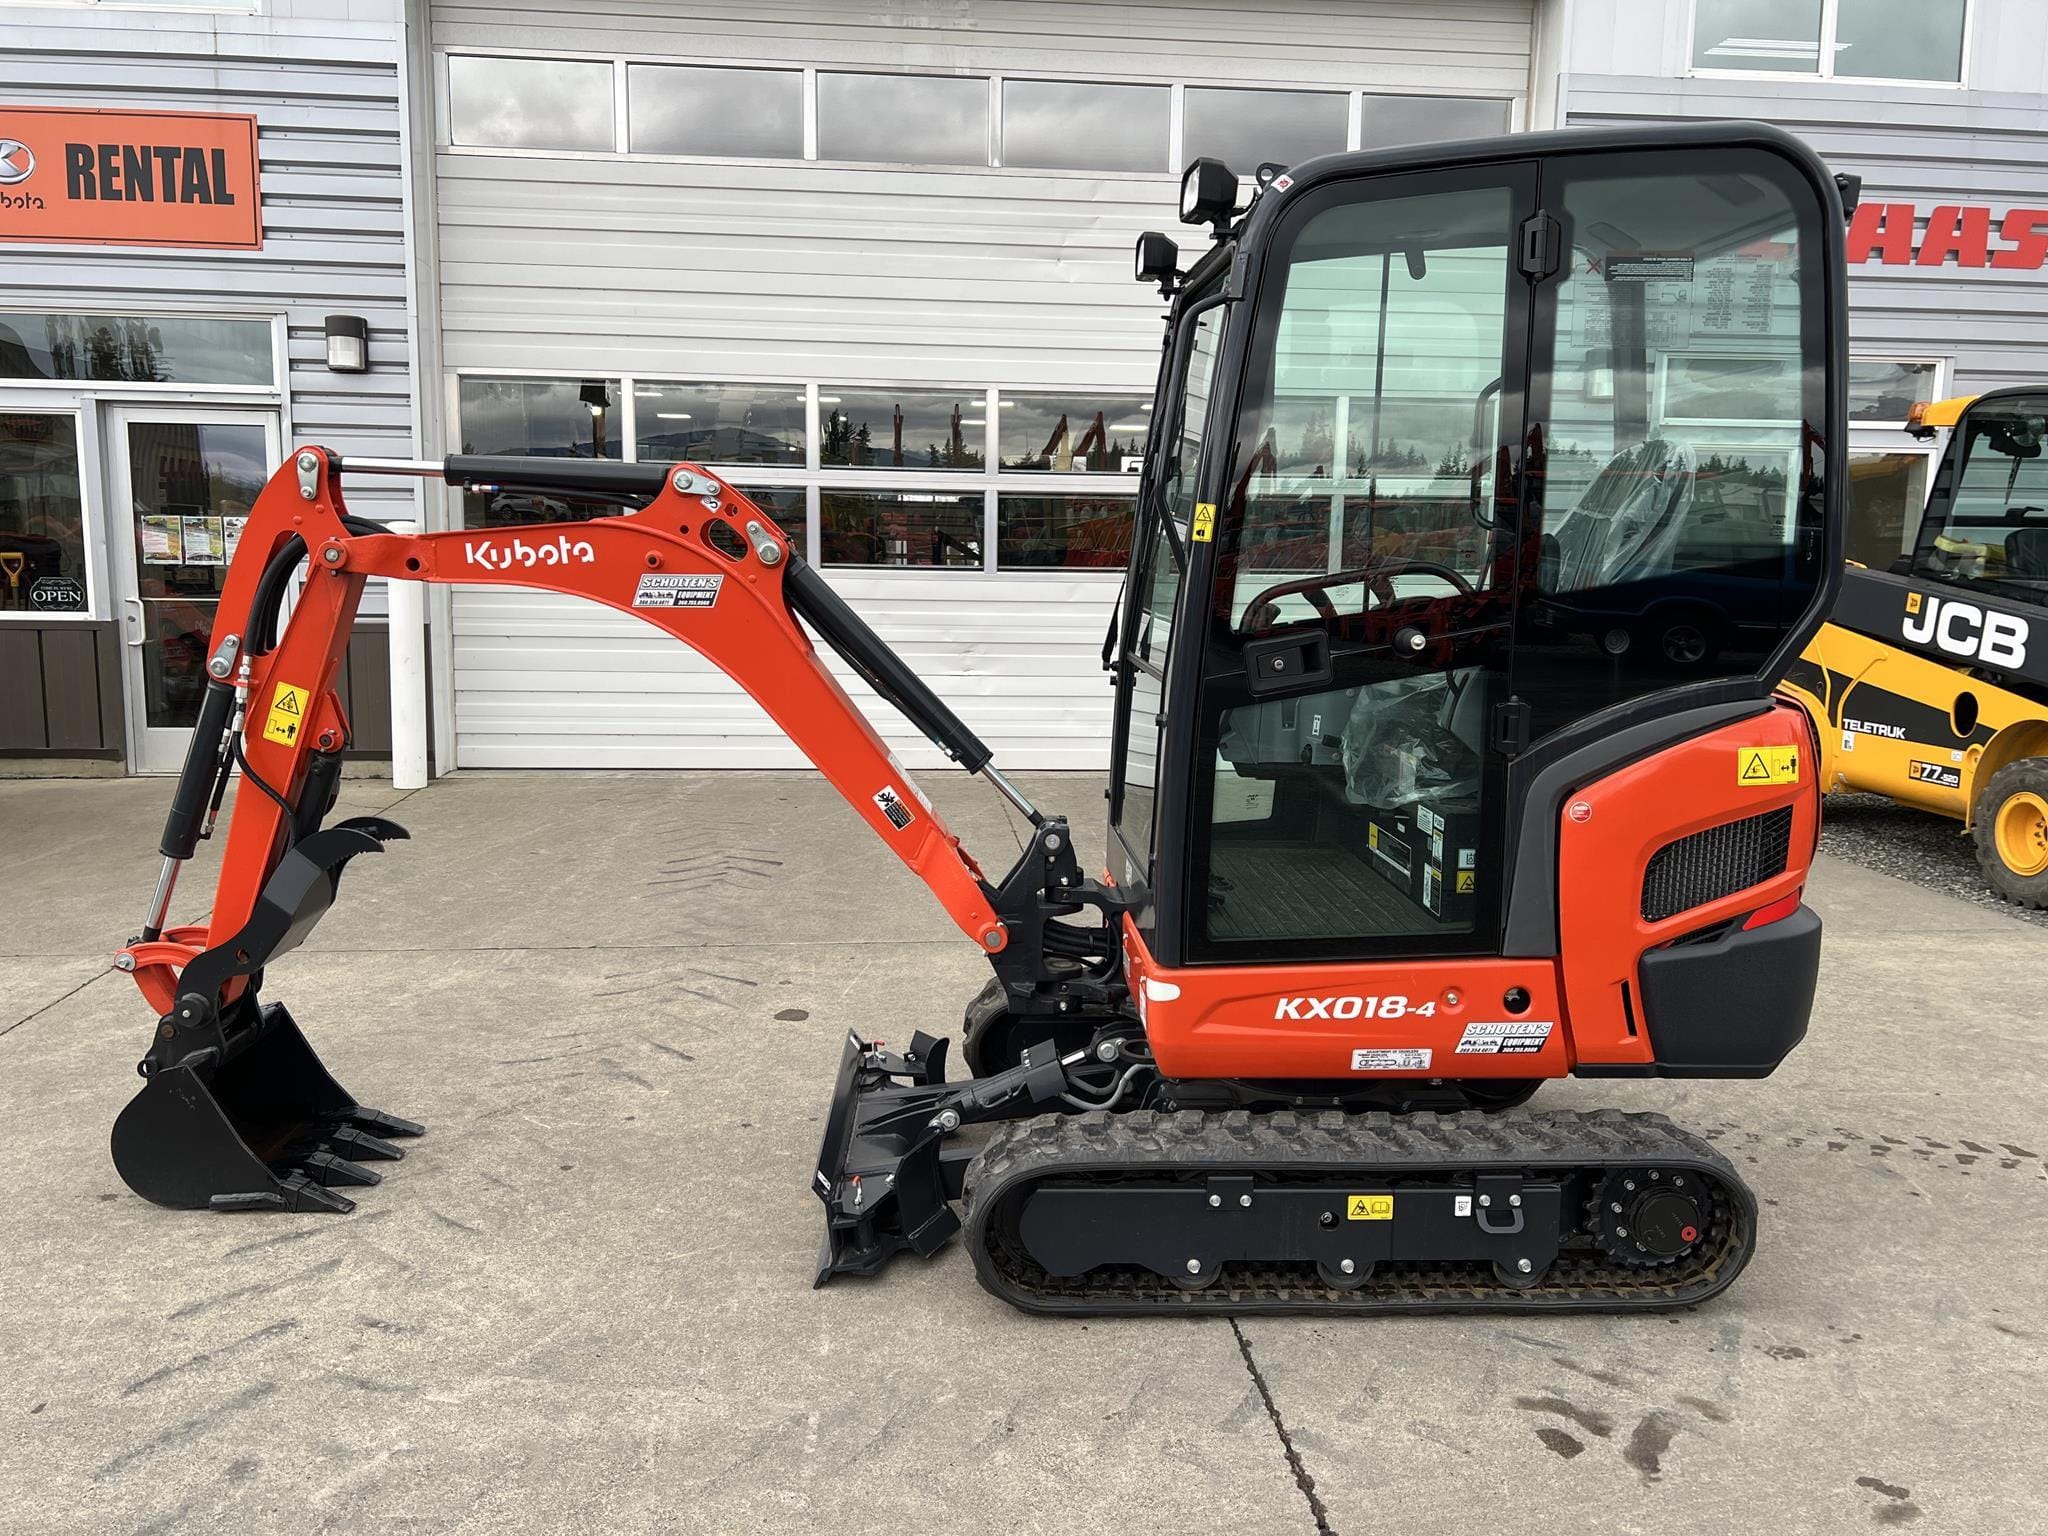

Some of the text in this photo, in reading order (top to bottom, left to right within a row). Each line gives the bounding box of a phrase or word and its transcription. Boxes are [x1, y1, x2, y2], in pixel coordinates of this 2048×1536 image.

[65, 143, 235, 205] RENTAL
[465, 535, 595, 570] Kubota
[642, 576, 718, 588] SCHOLTEN'S
[33, 590, 81, 602] OPEN
[677, 591, 715, 599] EQUIPMENT
[1902, 596, 2029, 669] JCB
[1842, 718, 1906, 739] TELETRUK
[1274, 995, 1436, 1020] KX018-4
[1466, 1023, 1551, 1035] SCHOLTEN'S
[1503, 1038, 1546, 1046] EQUIPMENT
